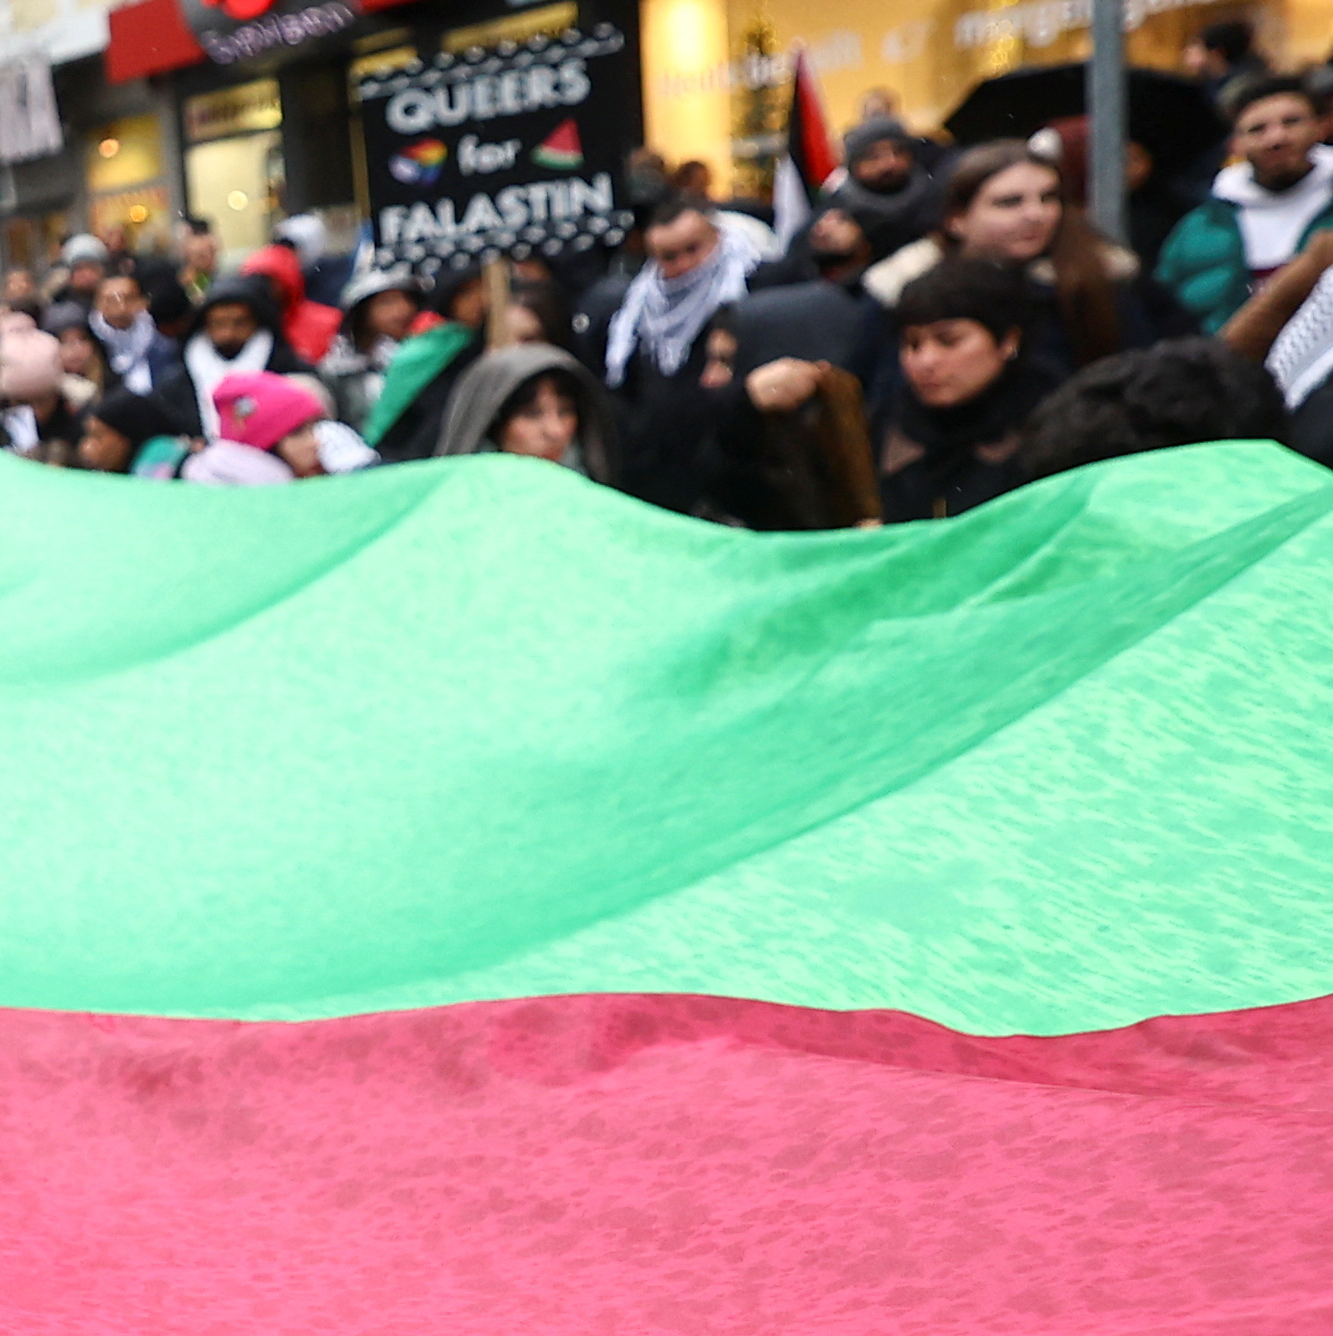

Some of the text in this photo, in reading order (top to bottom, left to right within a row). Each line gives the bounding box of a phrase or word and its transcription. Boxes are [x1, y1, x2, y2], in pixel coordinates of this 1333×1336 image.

[386, 58, 591, 136] QUEERS
[457, 133, 522, 176] for
[380, 171, 613, 246] FALASTIN
